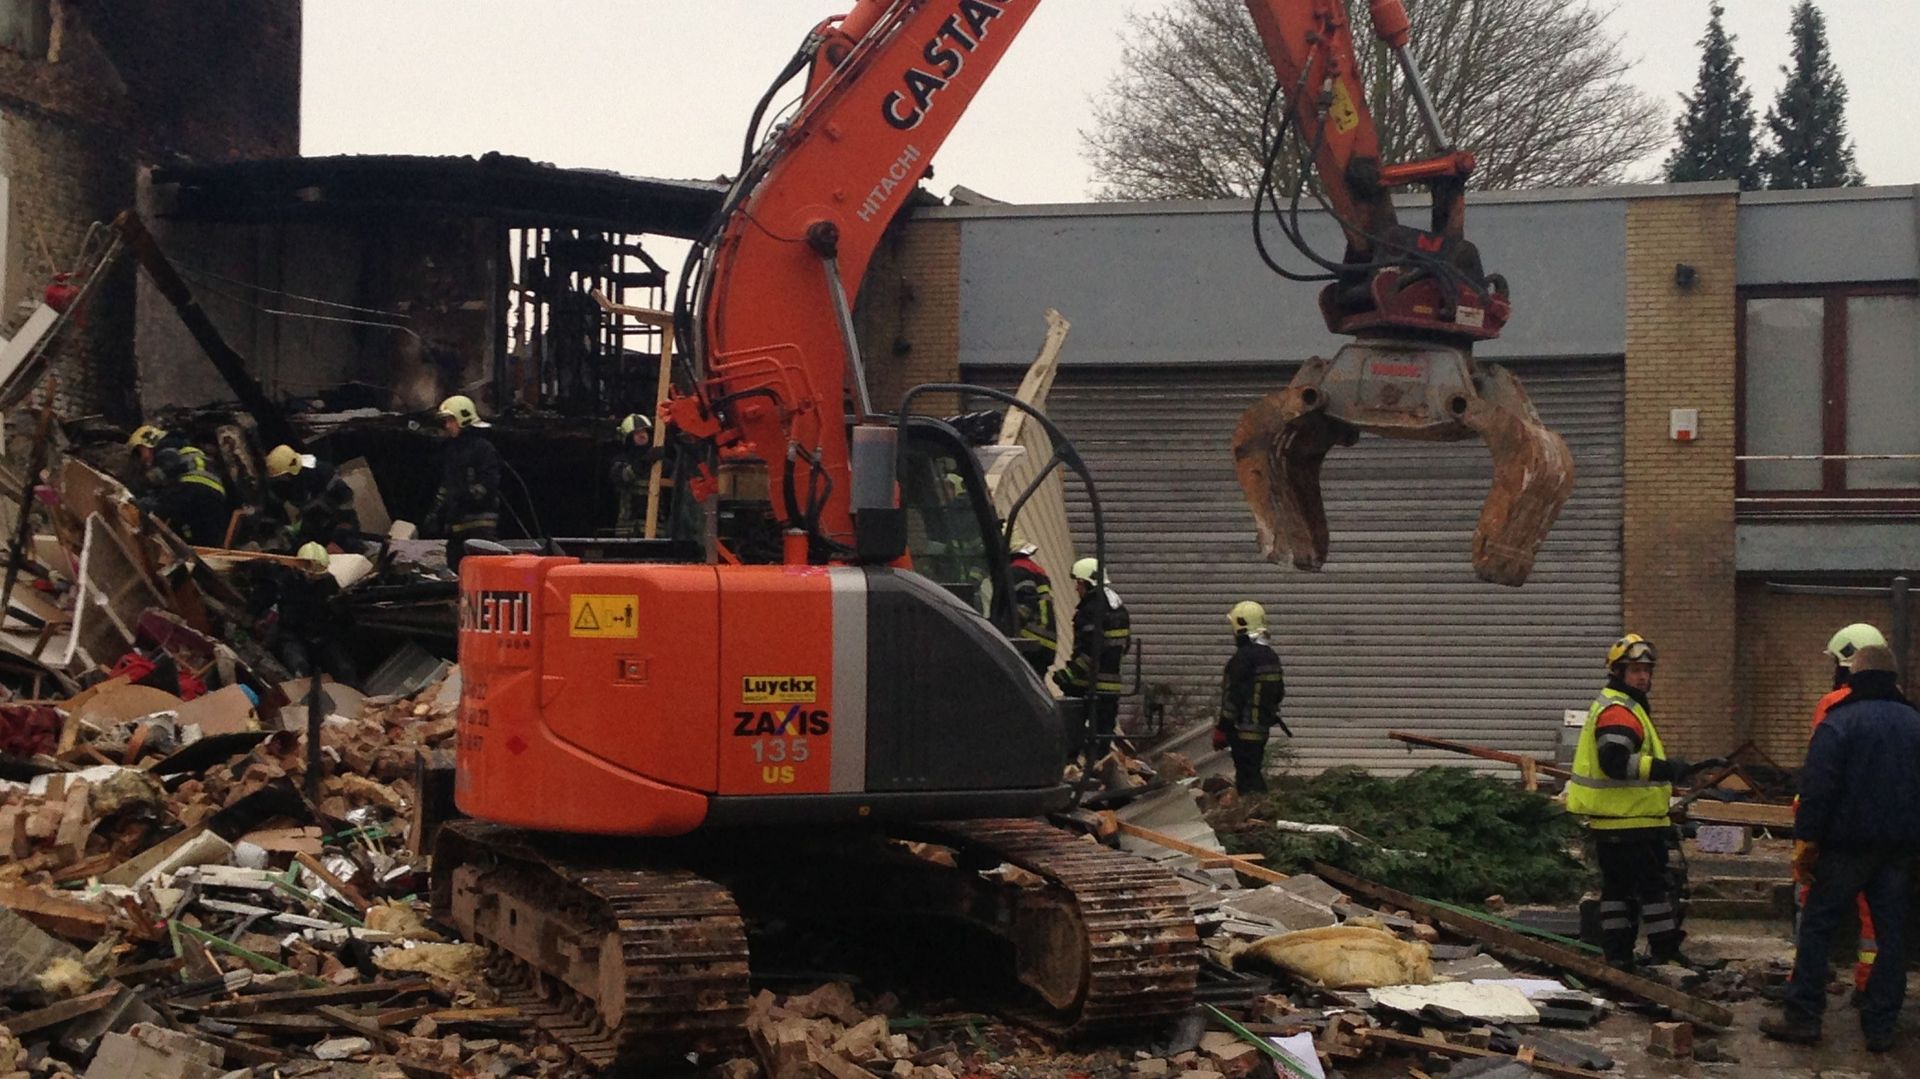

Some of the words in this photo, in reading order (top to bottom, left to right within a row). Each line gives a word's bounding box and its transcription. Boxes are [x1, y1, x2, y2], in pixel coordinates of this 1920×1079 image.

[881, 0, 1013, 130] CASTA
[856, 144, 921, 222] HITACHI
[460, 590, 532, 635] NETTI
[744, 678, 815, 695] Luyckx
[733, 704, 830, 736] ZAXIS
[751, 738, 809, 763] 135
[762, 765, 795, 784] US
